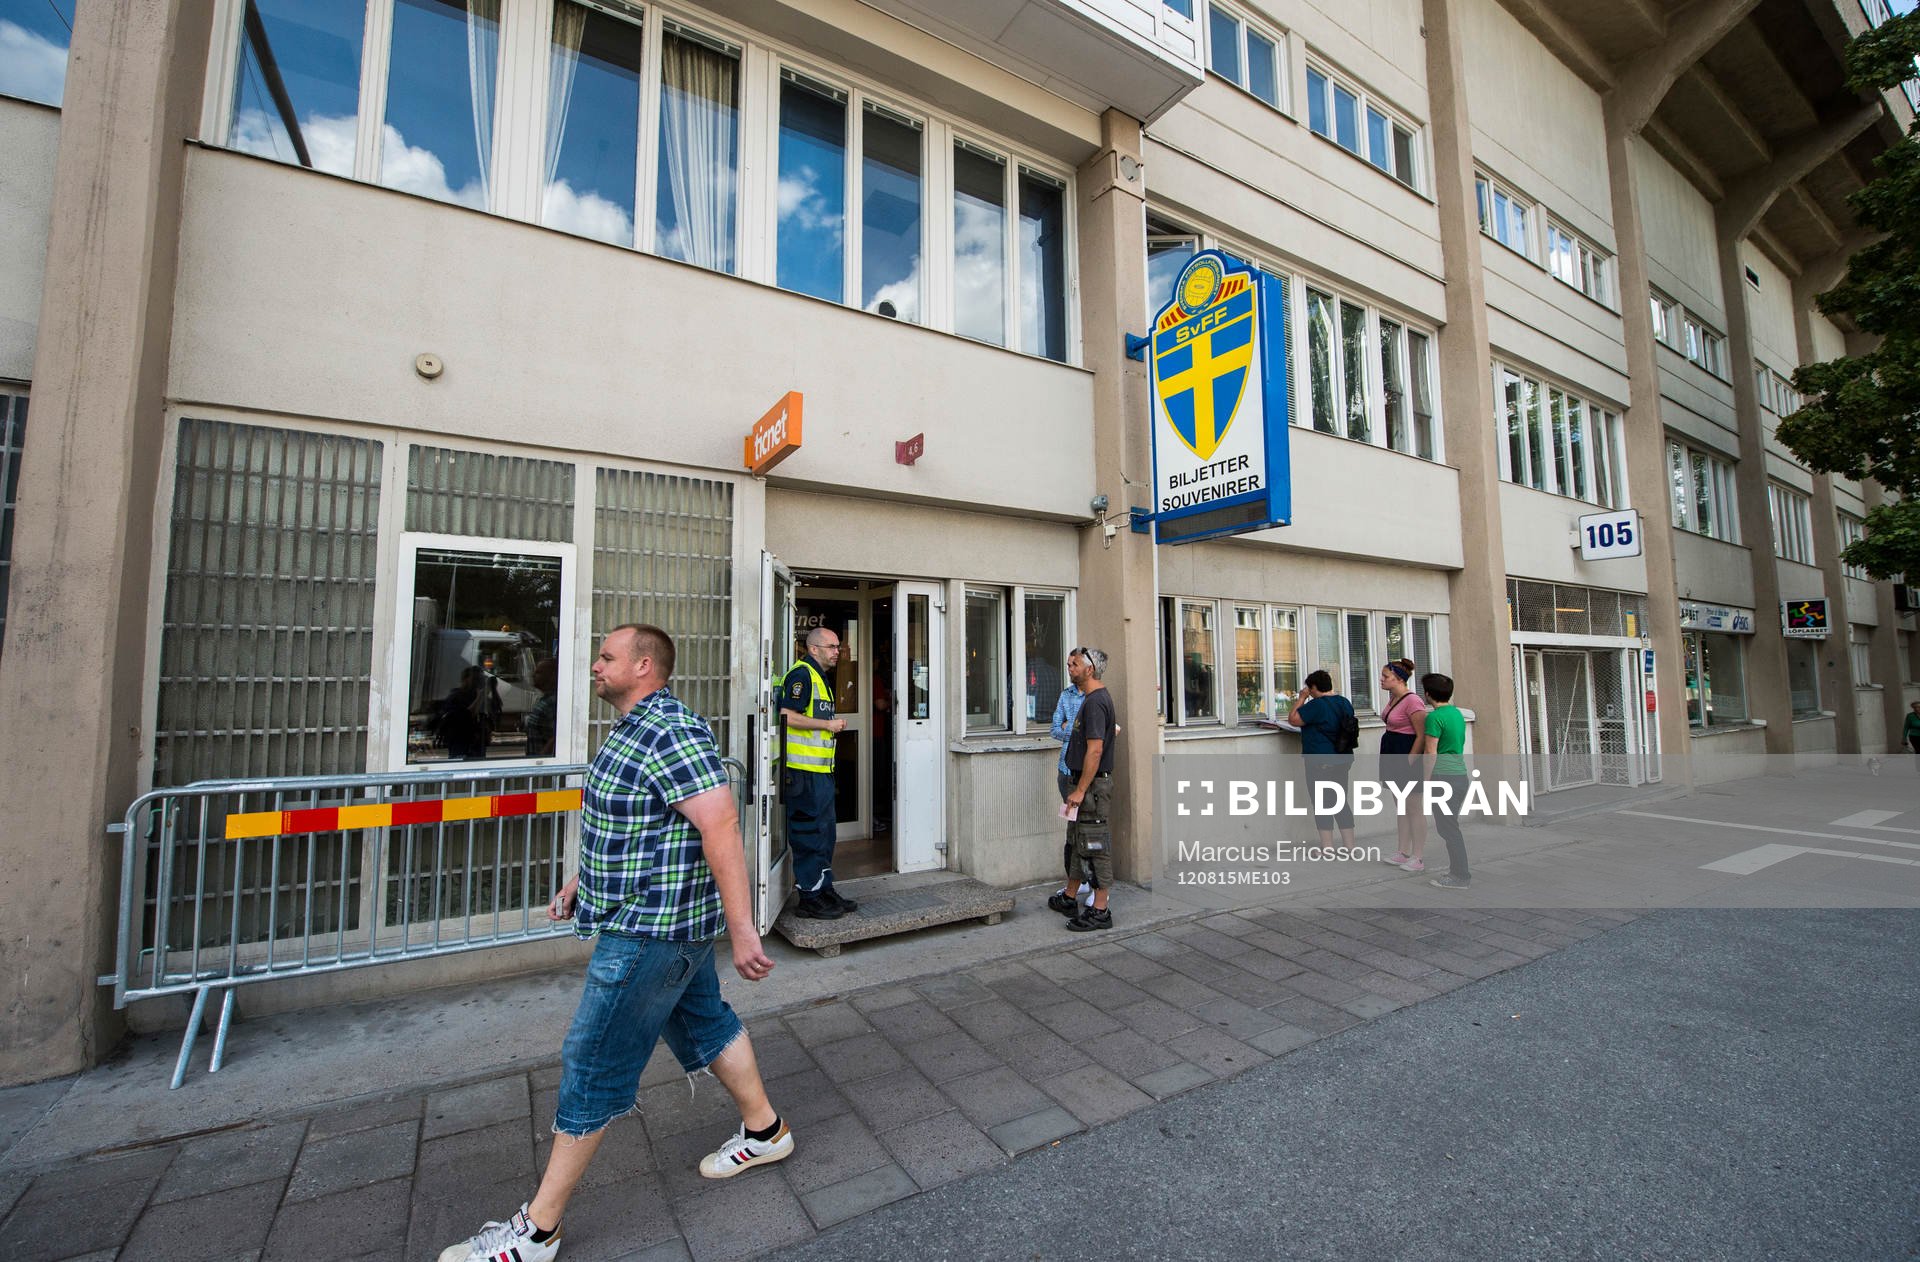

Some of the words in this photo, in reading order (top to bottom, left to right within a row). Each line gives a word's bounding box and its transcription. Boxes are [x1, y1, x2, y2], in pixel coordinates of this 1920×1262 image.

[1176, 306, 1228, 343] SvFF
[754, 407, 788, 461] ticnet
[1169, 454, 1249, 489] BILJETTER
[1162, 474, 1260, 512] SOUVENIRER
[1586, 520, 1633, 549] 105
